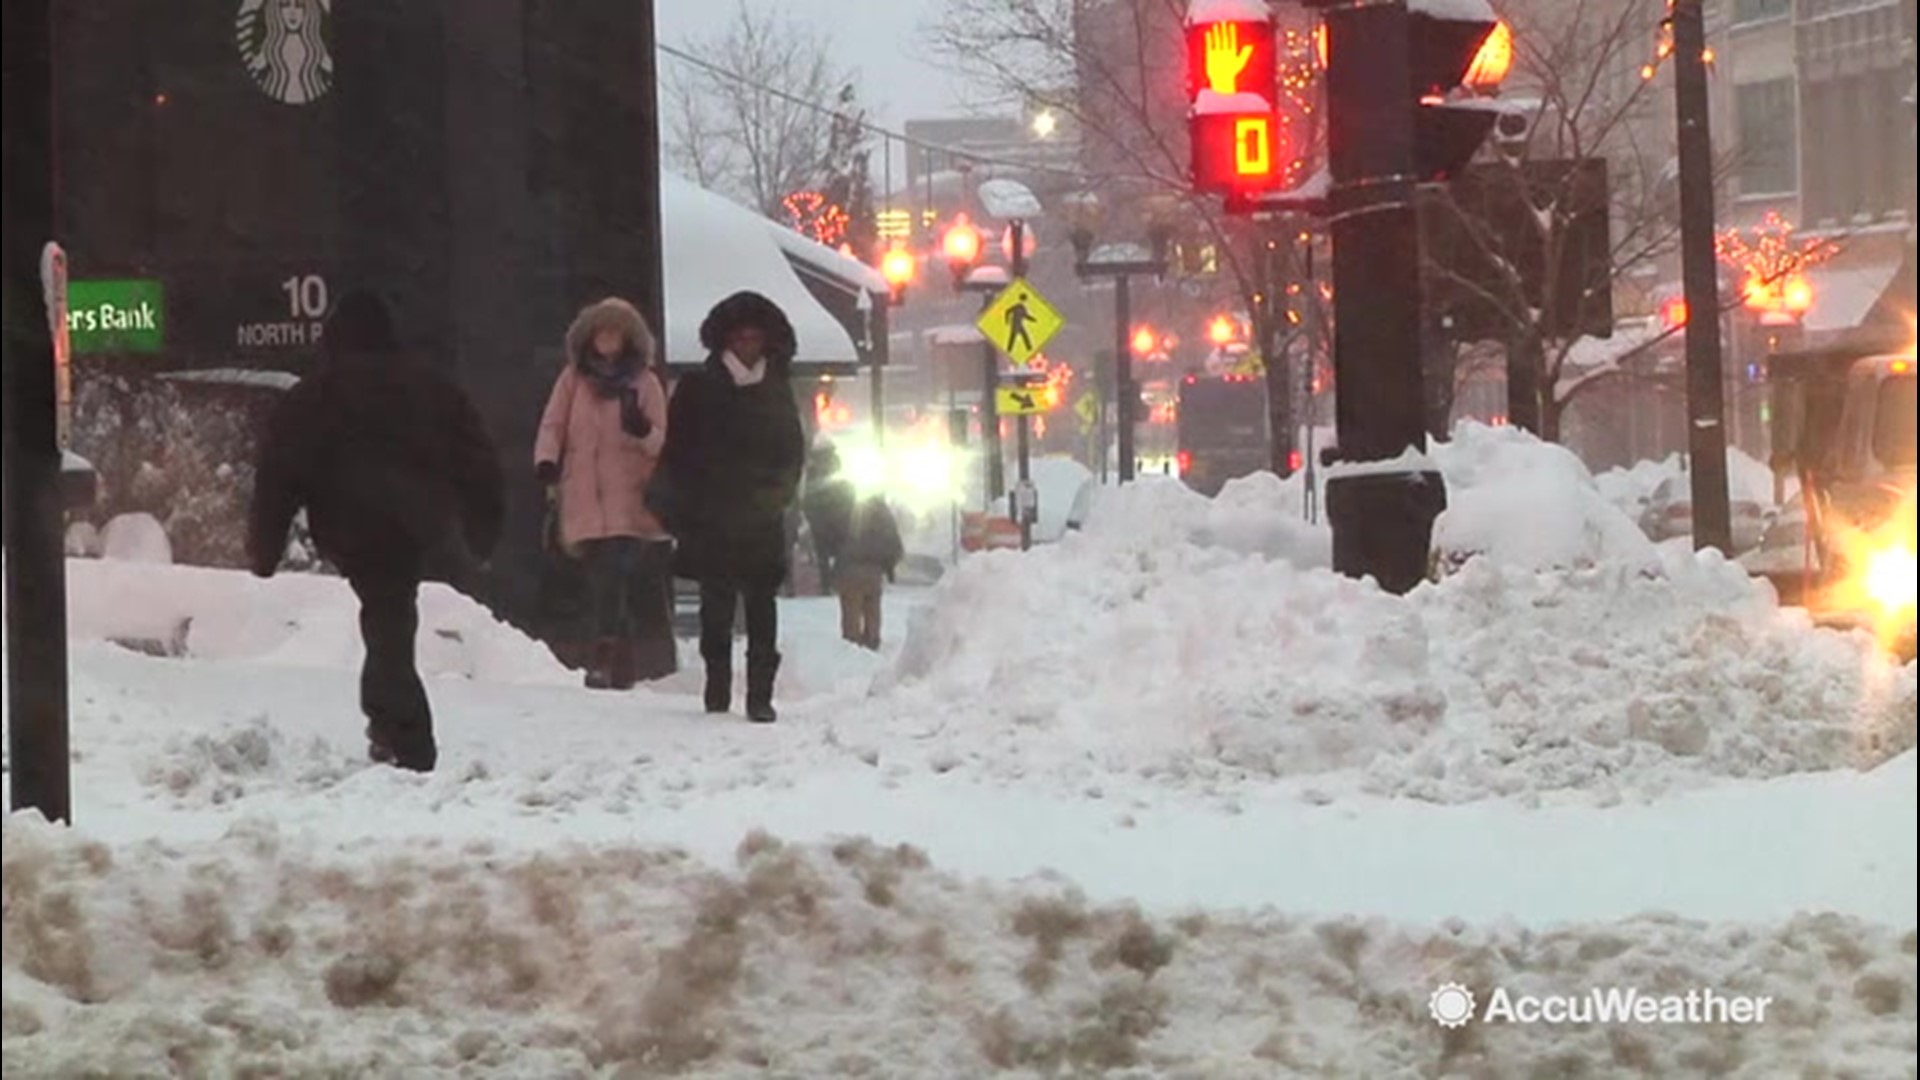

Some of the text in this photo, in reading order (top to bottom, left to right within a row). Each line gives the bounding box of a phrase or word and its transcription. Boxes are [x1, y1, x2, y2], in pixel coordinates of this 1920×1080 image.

[282, 275, 328, 318] 10
[100, 302, 155, 330] Bank
[238, 323, 305, 345] NORTH
